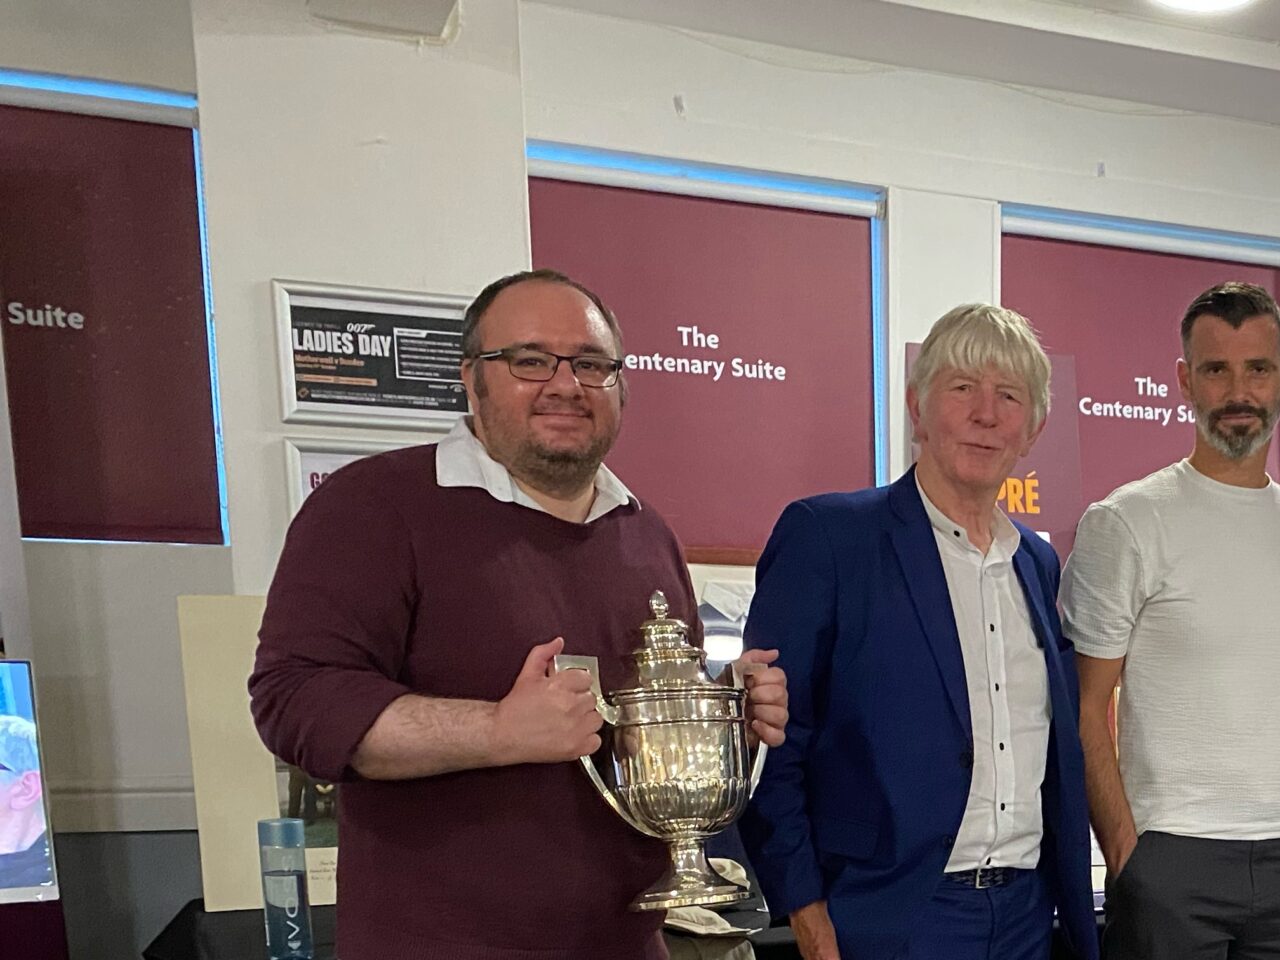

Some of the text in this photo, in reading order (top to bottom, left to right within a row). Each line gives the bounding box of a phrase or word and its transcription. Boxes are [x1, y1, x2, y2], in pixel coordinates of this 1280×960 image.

[8, 302, 84, 329] Suite
[346, 322, 372, 334] 007
[291, 328, 392, 358] LADIES DAY
[677, 325, 720, 349] The
[624, 352, 787, 382] entenary Suite
[1134, 376, 1168, 398] The
[1078, 396, 1172, 427] Centenary
